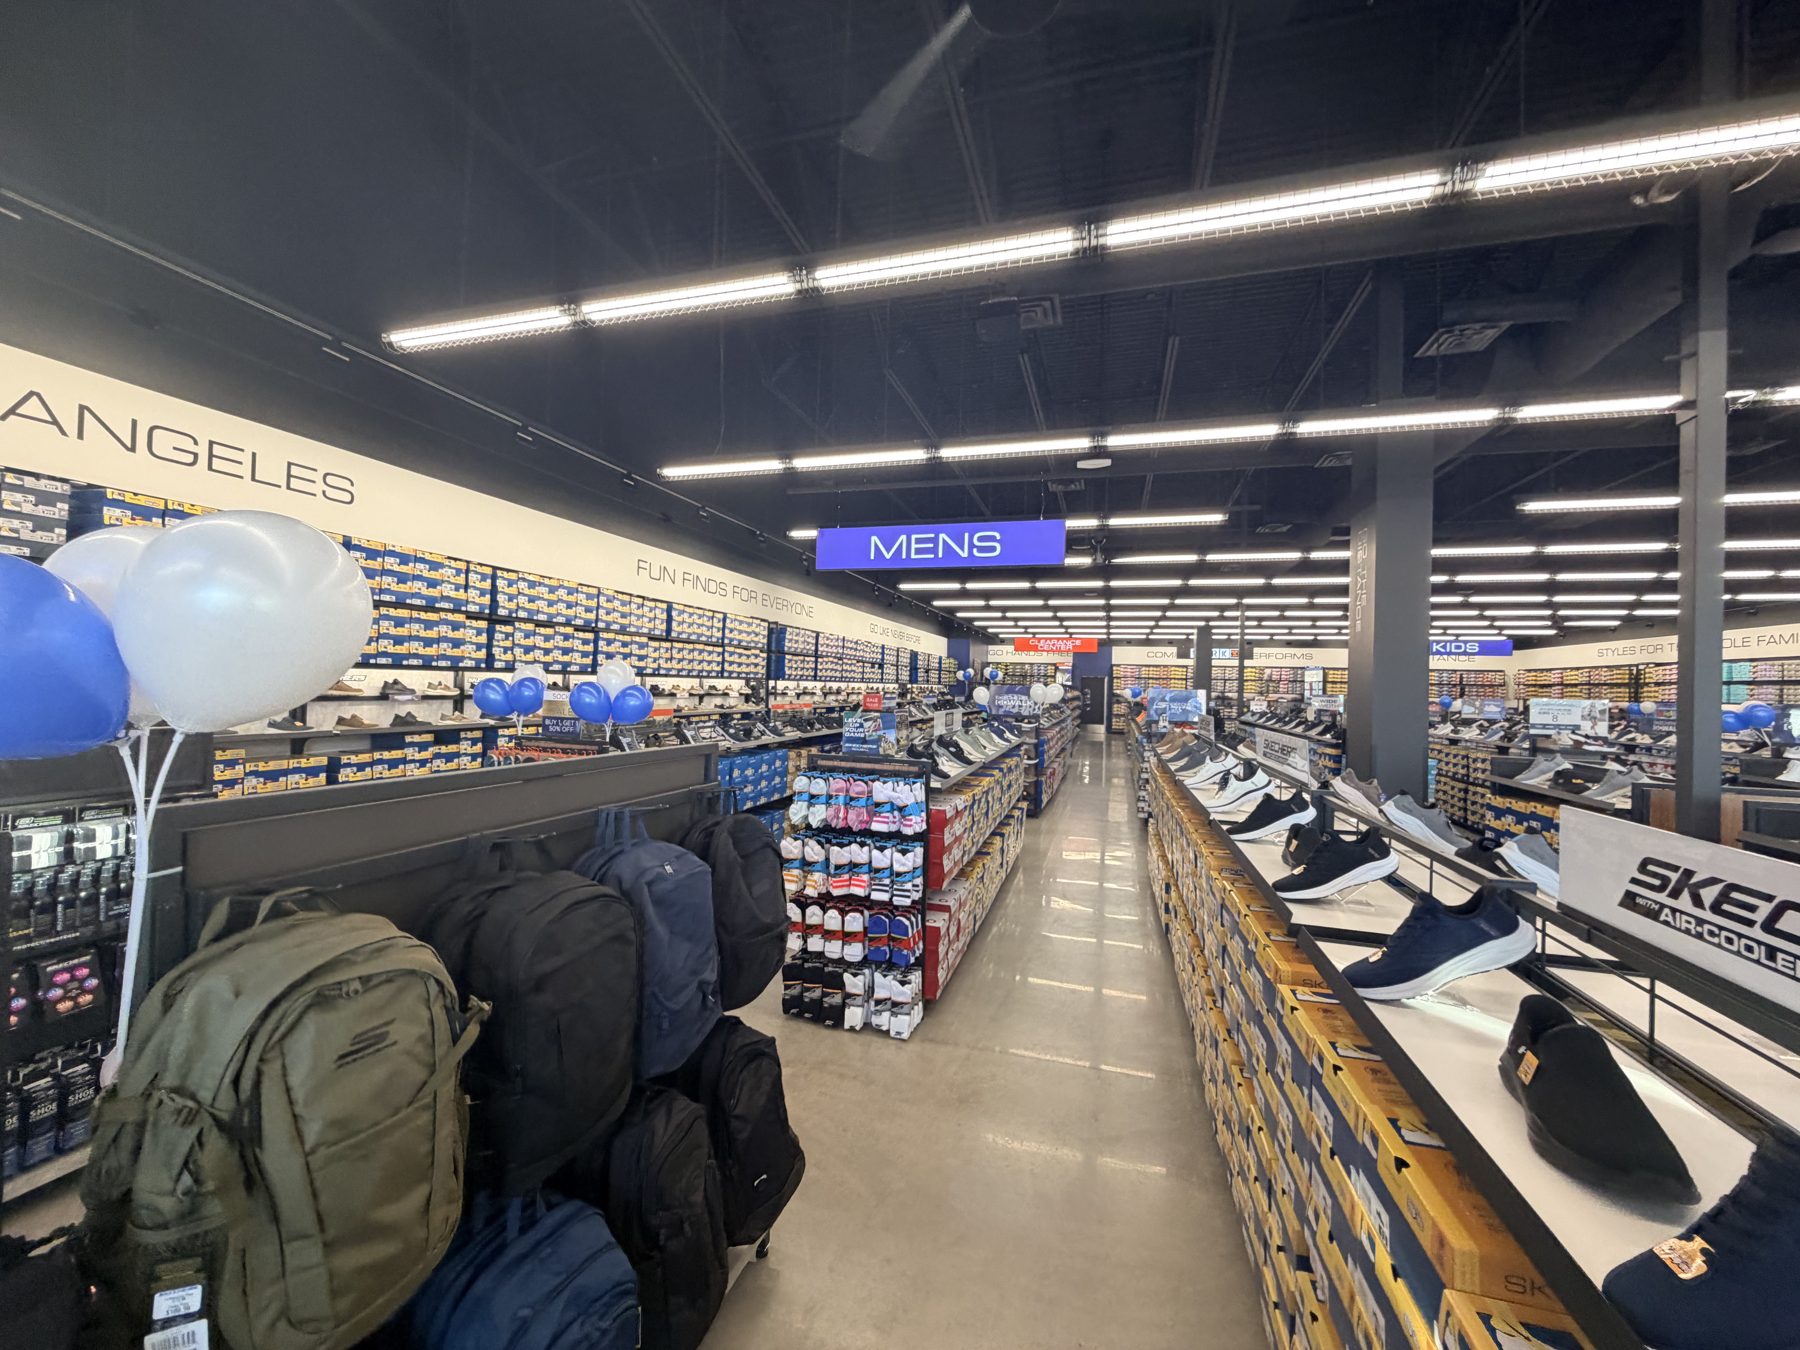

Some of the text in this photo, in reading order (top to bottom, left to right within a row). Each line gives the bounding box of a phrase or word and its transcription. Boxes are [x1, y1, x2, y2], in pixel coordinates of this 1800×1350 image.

[0, 389, 356, 506] ANGELES
[870, 531, 1001, 560] MENS
[637, 559, 815, 619] FUN FINDS FOR EVERYONE
[869, 622, 879, 635] GO
[879, 626, 890, 638] LIKE
[890, 628, 906, 641] NEVER
[988, 649, 1004, 657] GO
[1432, 642, 1480, 653] KIDS
[1597, 646, 1637, 658] STYLES
[1640, 643, 1664, 654] FOR
[545, 718, 557, 726] BUY
[1551, 714, 1559, 723] 8
[1635, 895, 1800, 978] WITH AIR-COOLE
[68, 1087, 96, 1101] SHOE
[29, 1102, 58, 1117] SHOE
